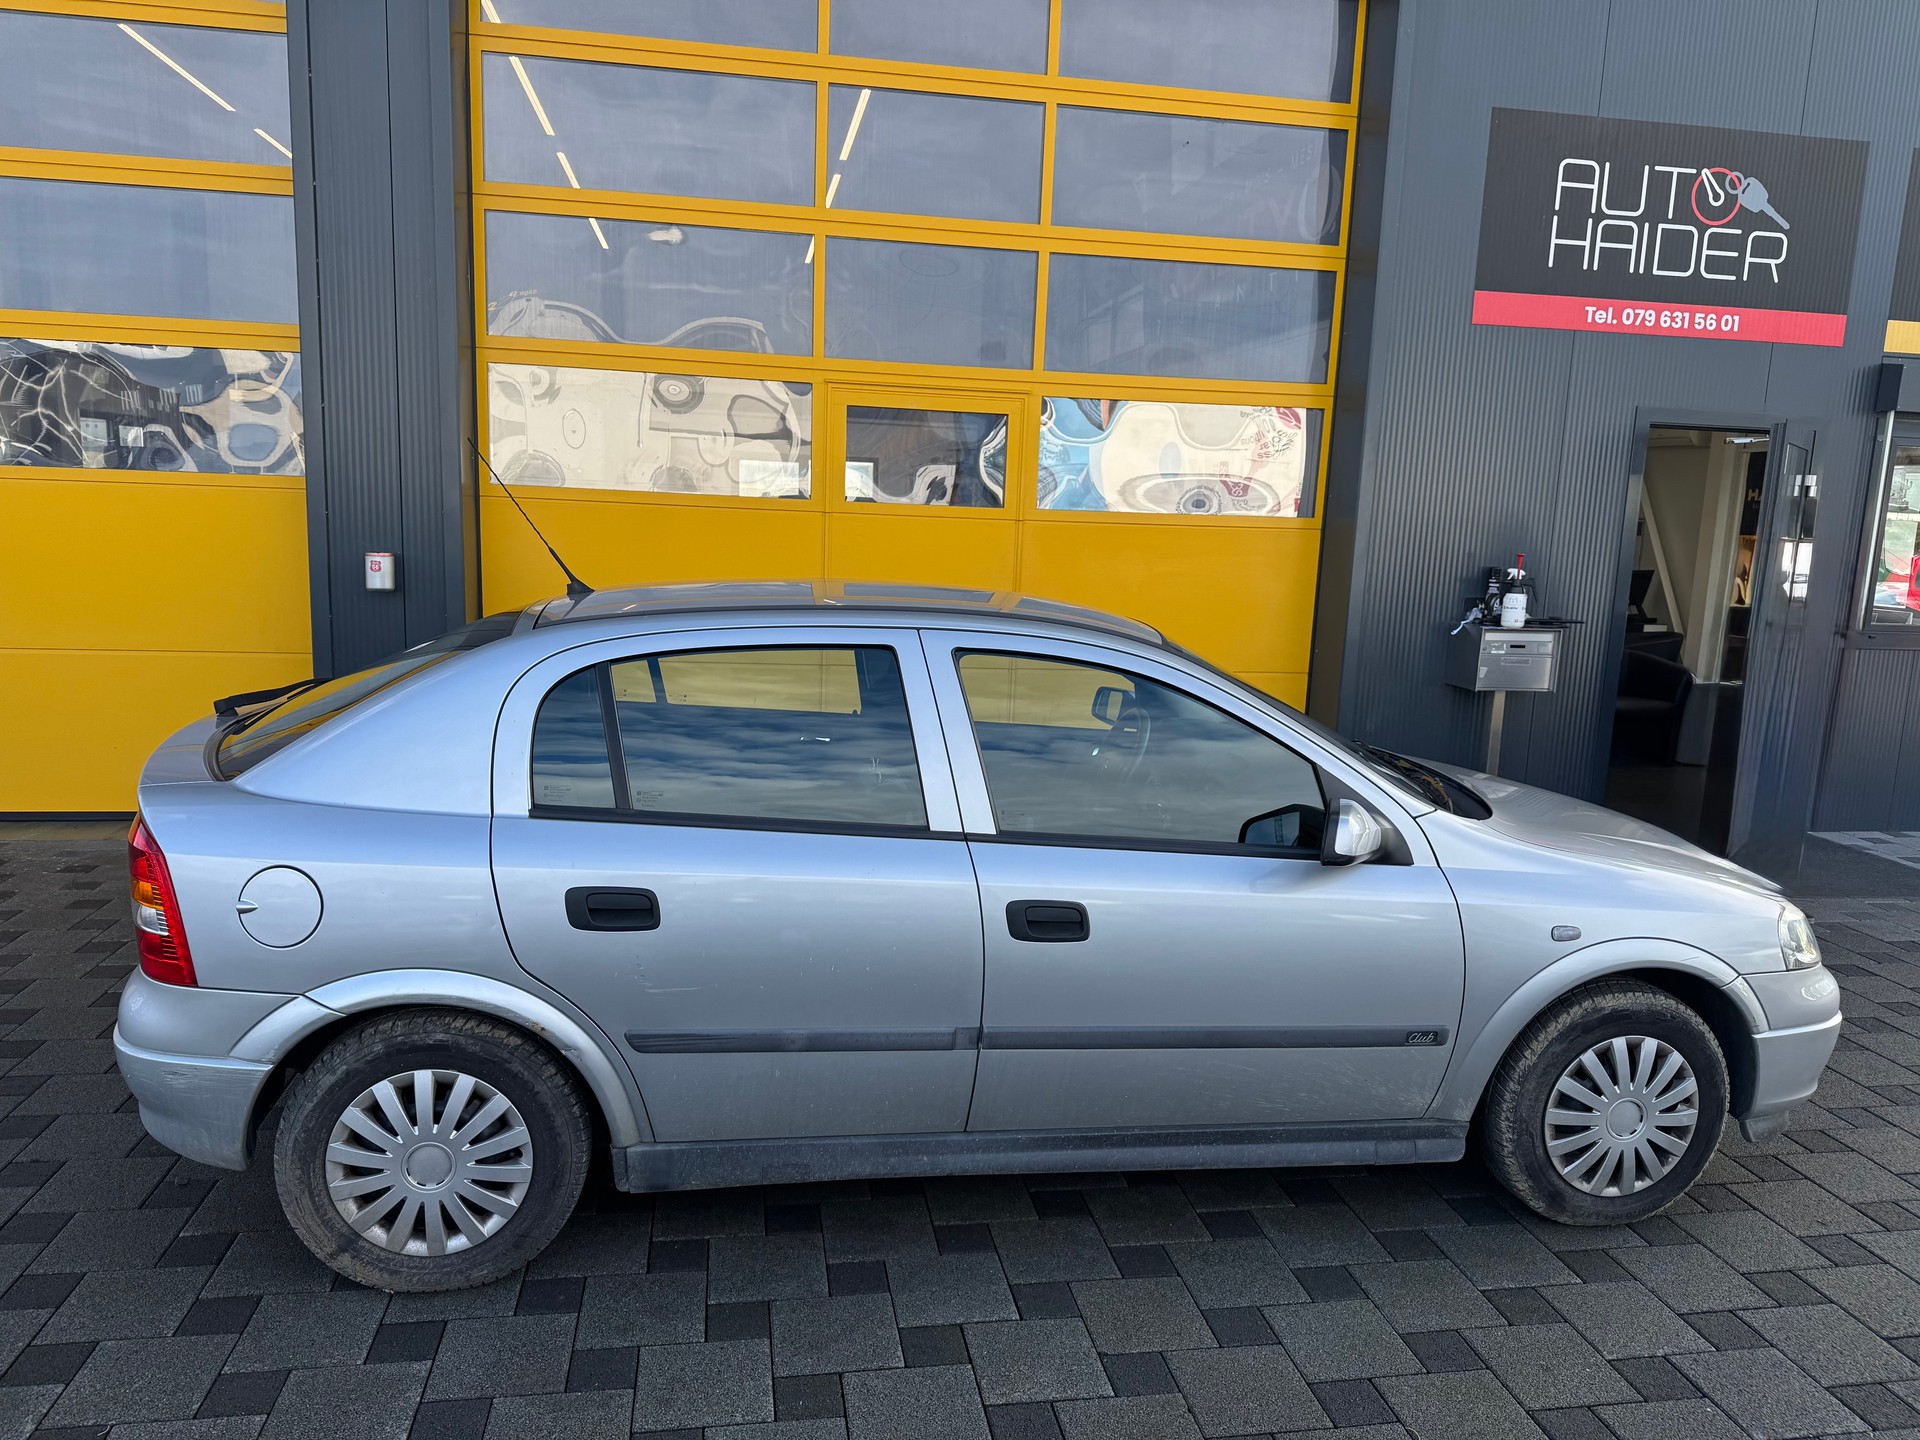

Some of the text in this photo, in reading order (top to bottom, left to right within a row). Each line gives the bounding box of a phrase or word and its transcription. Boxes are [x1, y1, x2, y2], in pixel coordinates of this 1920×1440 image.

[1554, 158, 1741, 225] AUTO
[1548, 215, 1788, 283] HAIDER
[1584, 306, 1740, 332] Tel. 079 631 56 01
[1408, 1032, 1435, 1043] Club
